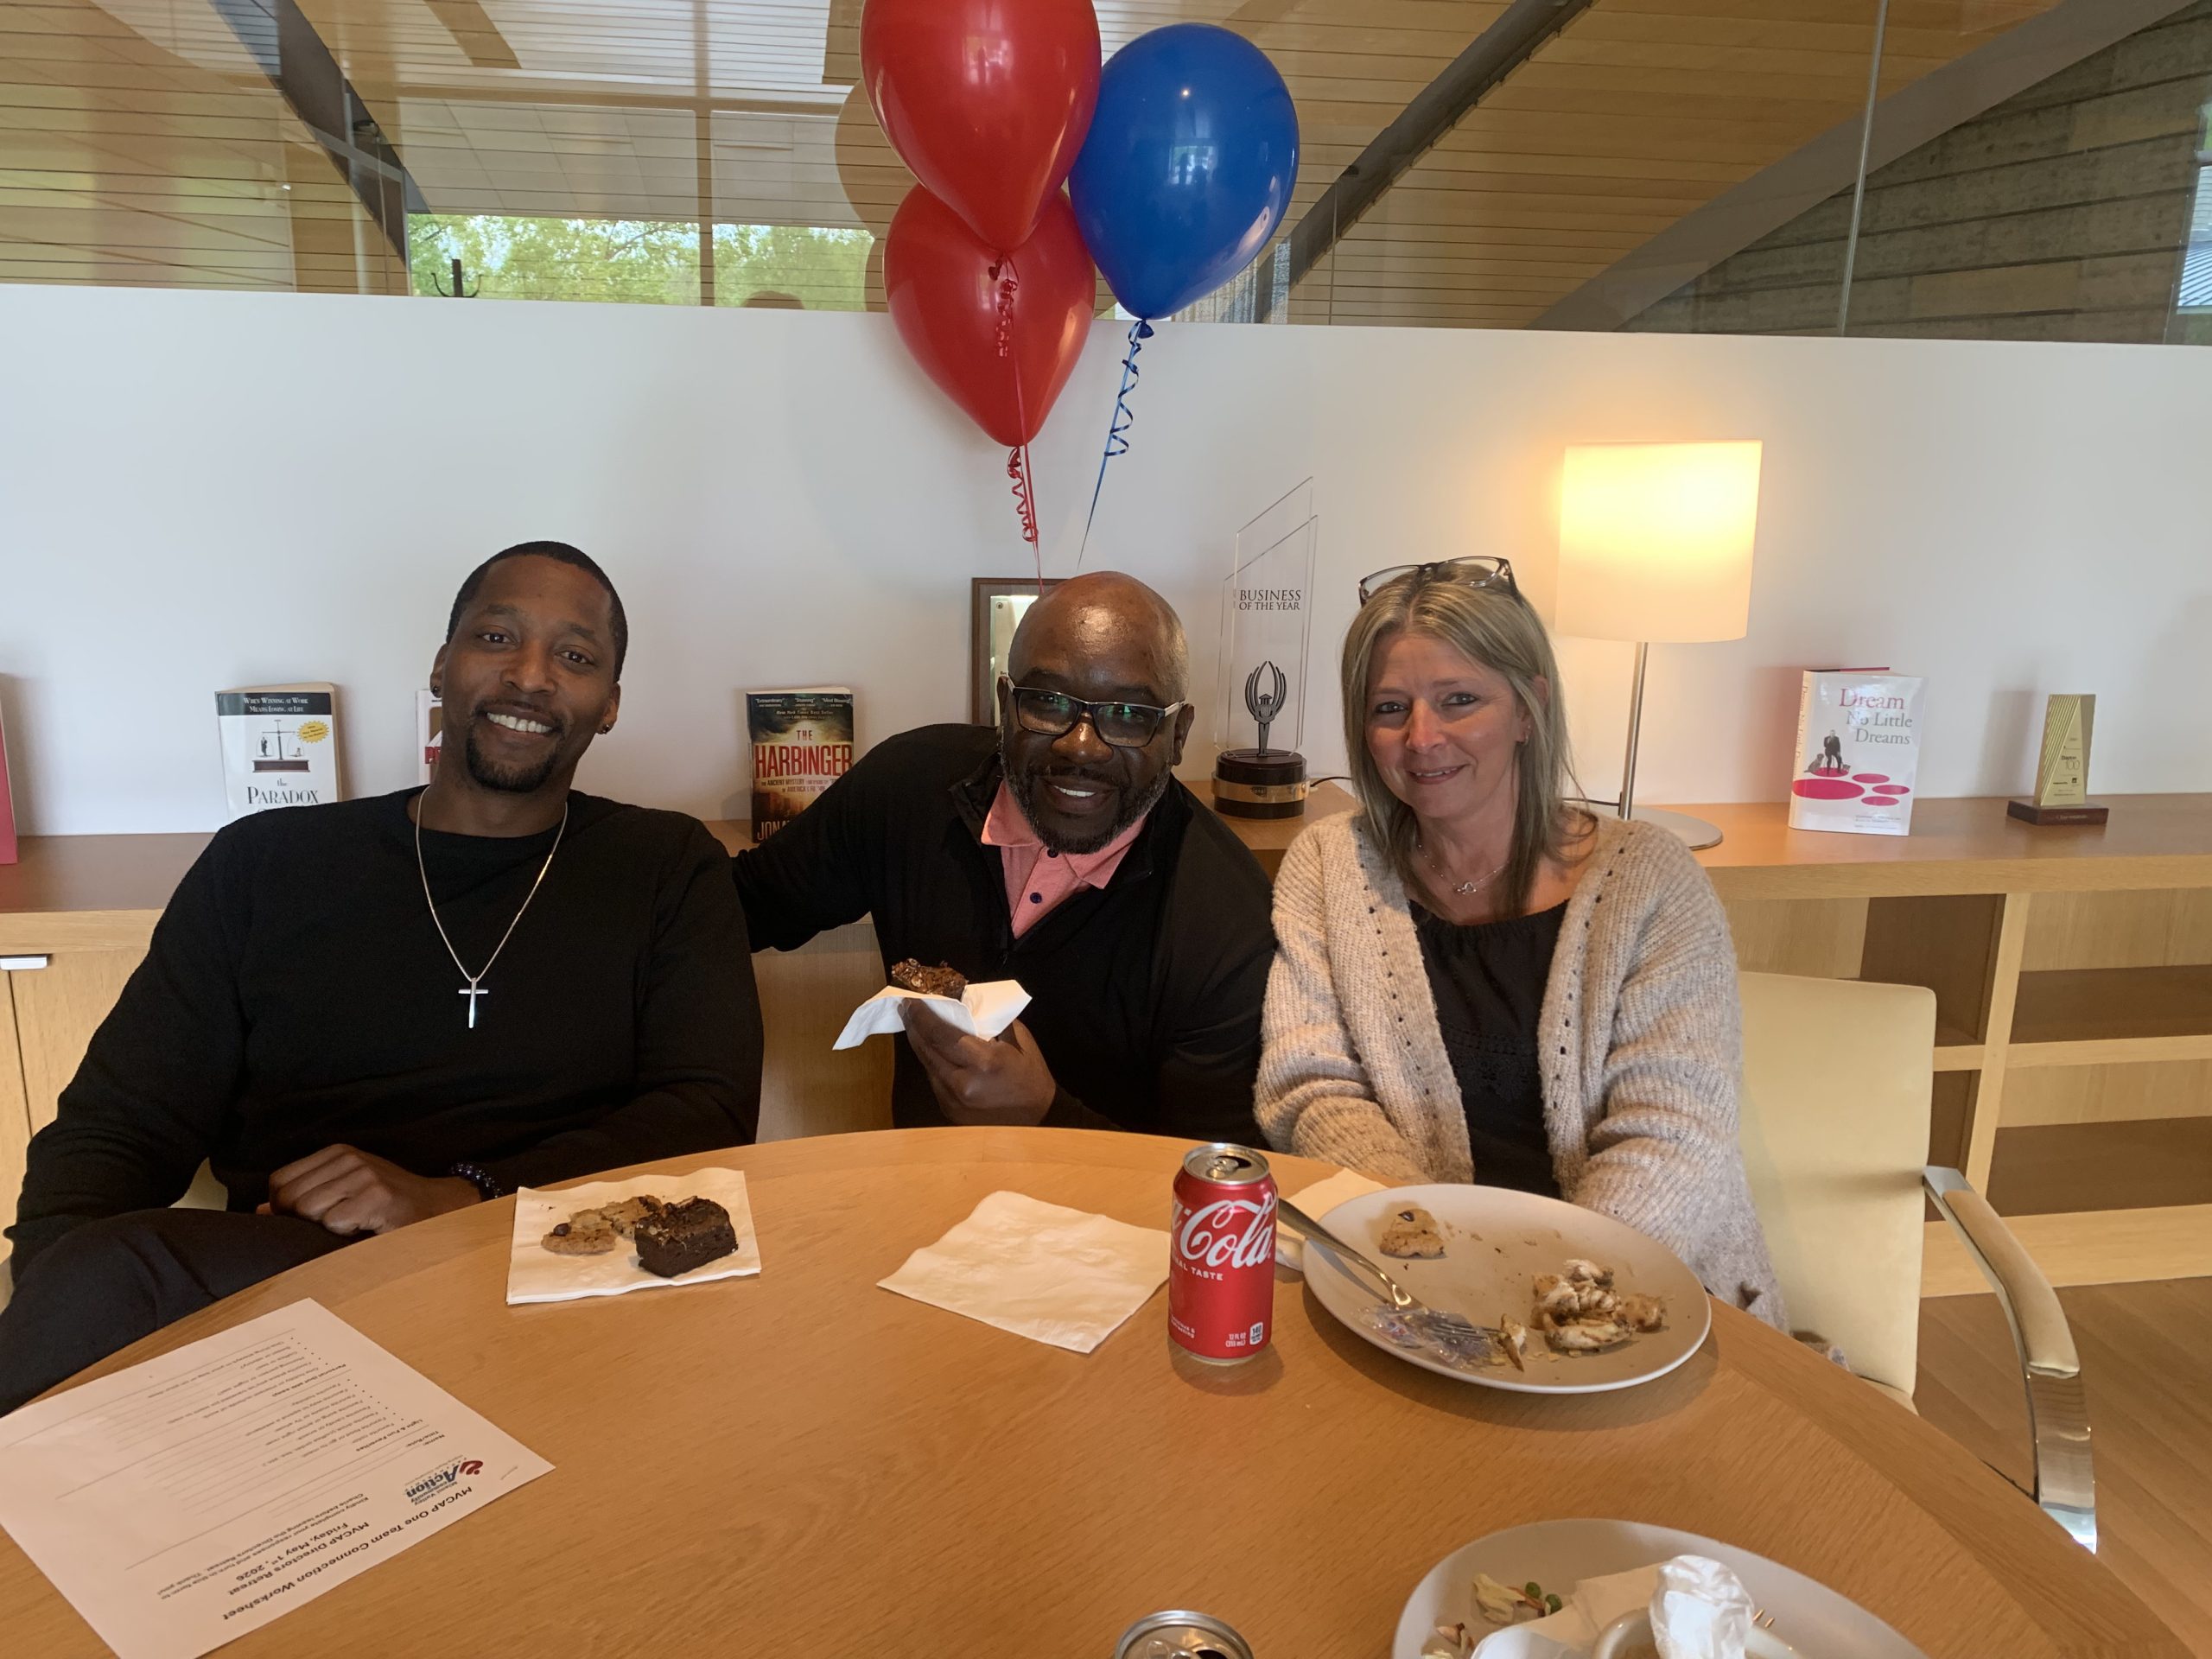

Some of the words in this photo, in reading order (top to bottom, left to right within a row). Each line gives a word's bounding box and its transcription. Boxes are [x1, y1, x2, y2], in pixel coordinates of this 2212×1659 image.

[1239, 589, 1301, 601] BUSINESS
[1238, 601, 1252, 611] OF
[1255, 601, 1274, 611] THE
[1276, 601, 1300, 611] YEAR
[1839, 688, 1905, 709] Dream
[1846, 710, 1869, 725] No
[1874, 712, 1913, 728] Little
[797, 730, 813, 741] THE
[1855, 728, 1910, 745] Dreams
[755, 744, 853, 779] HARBINGER
[276, 778, 287, 786] the
[247, 786, 319, 804] PARADOX
[1191, 1267, 1223, 1281] TASTE
[406, 1465, 459, 1497] Action
[431, 1486, 472, 1512] MVCAP
[404, 1510, 429, 1524] One
[309, 1522, 347, 1541] Friday,
[329, 1522, 369, 1544] MVCAP
[370, 1524, 404, 1542] Team
[273, 1542, 327, 1571] Directors
[285, 1541, 309, 1555] May
[296, 1542, 368, 1581] Connection
[235, 1564, 264, 1580] 2026
[228, 1571, 273, 1595] Retreat
[222, 1581, 295, 1619] Worksheet
